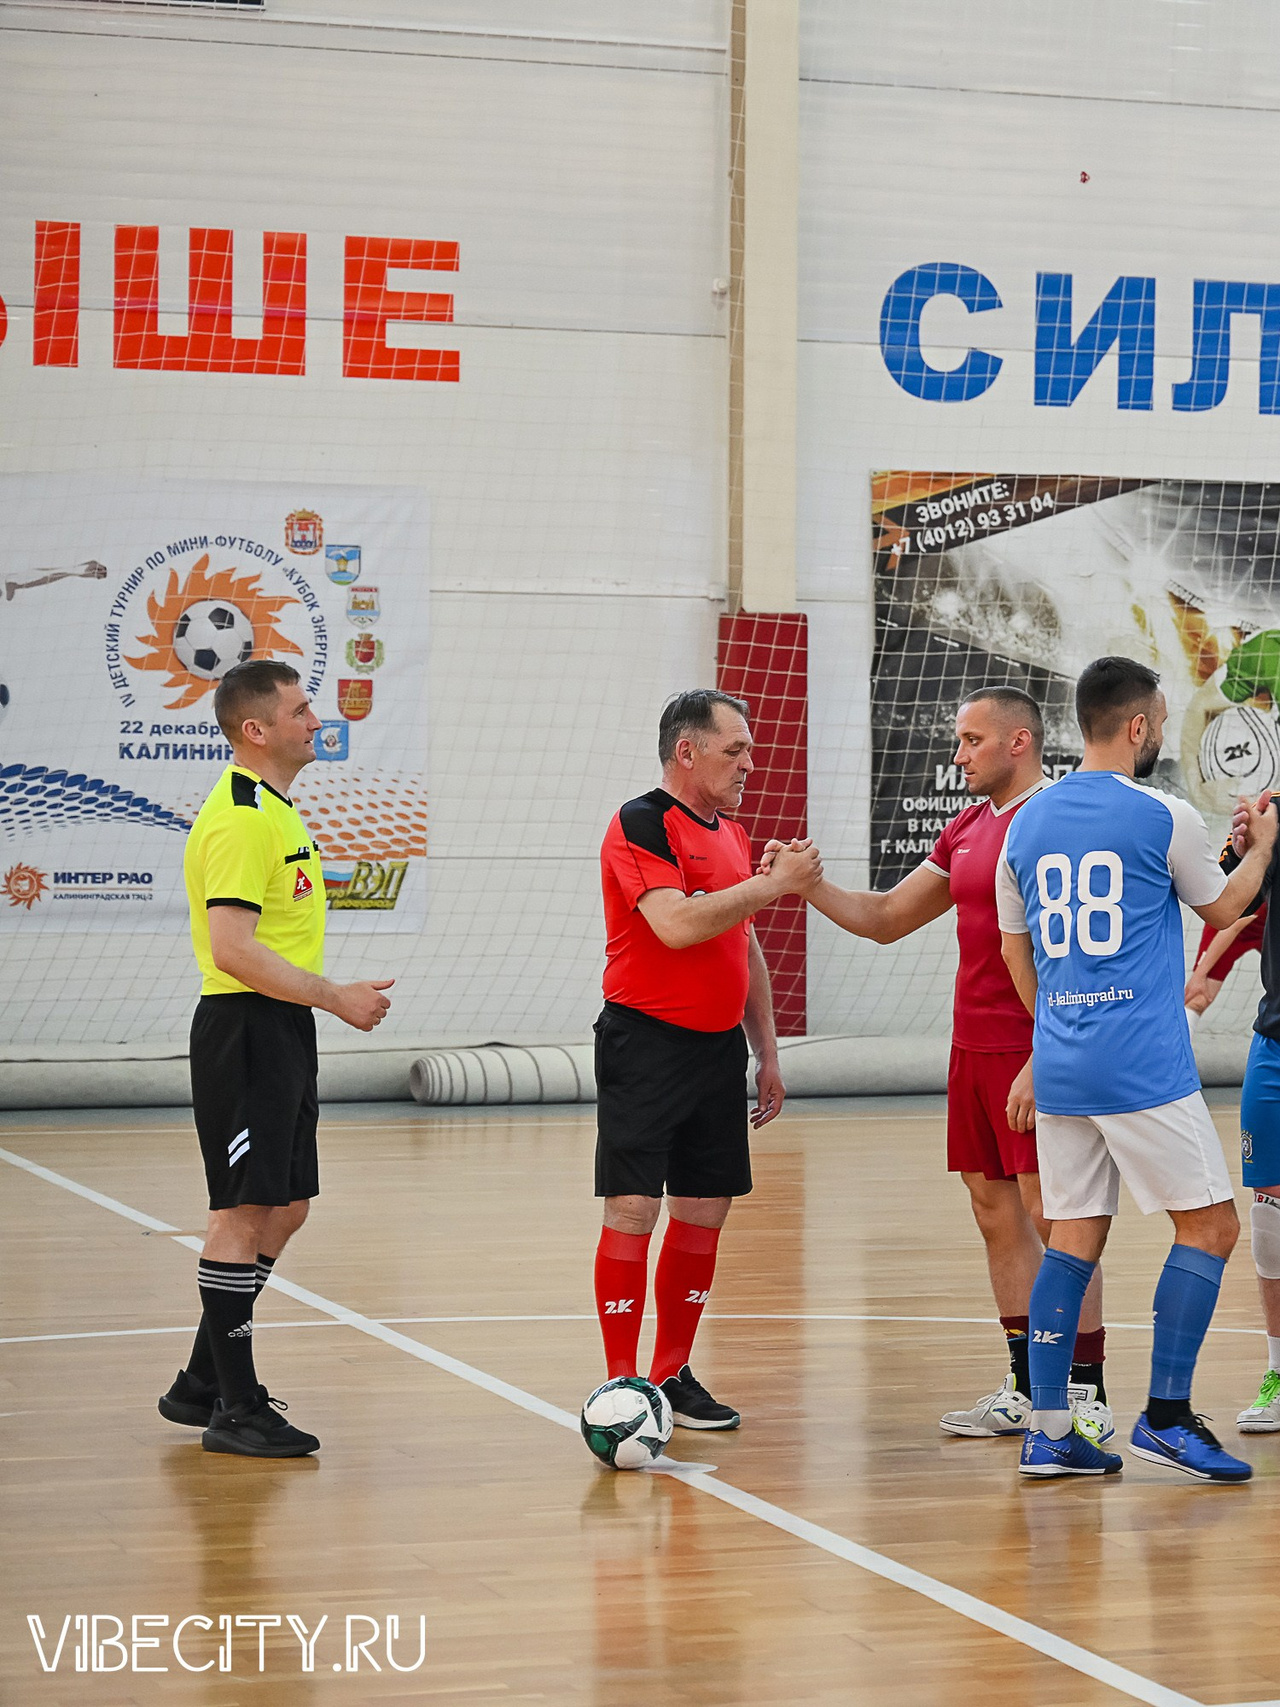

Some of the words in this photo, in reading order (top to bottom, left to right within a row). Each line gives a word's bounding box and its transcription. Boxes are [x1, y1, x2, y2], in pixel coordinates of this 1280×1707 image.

[915, 482, 1010, 523] ЗВОНИТЕ:
[916, 517, 975, 553] (4012)
[977, 508, 1001, 529] 93
[1003, 501, 1027, 521] 31
[1029, 492, 1054, 513] 04
[166, 535, 284, 567] МИНИ-ФУТБОЛУ
[145, 551, 166, 571] ПО
[110, 566, 145, 618] ТУРНИР
[104, 622, 130, 690] ДЕТСКИЙ
[119, 691, 136, 708] IV
[120, 721, 143, 734] 22
[149, 721, 223, 738] декабр
[119, 743, 234, 760] КАЛИНИН
[1224, 742, 1252, 761] 2K
[908, 818, 919, 832] В
[881, 839, 892, 853] Г.
[53, 872, 114, 884] ИНТЕР
[117, 872, 153, 884] РАО
[53, 893, 130, 901] КАЛИНИНГРАДСКАЯ
[1036, 850, 1124, 959] 88
[604, 1299, 635, 1315] 2K
[1032, 1330, 1064, 1345] 2K
